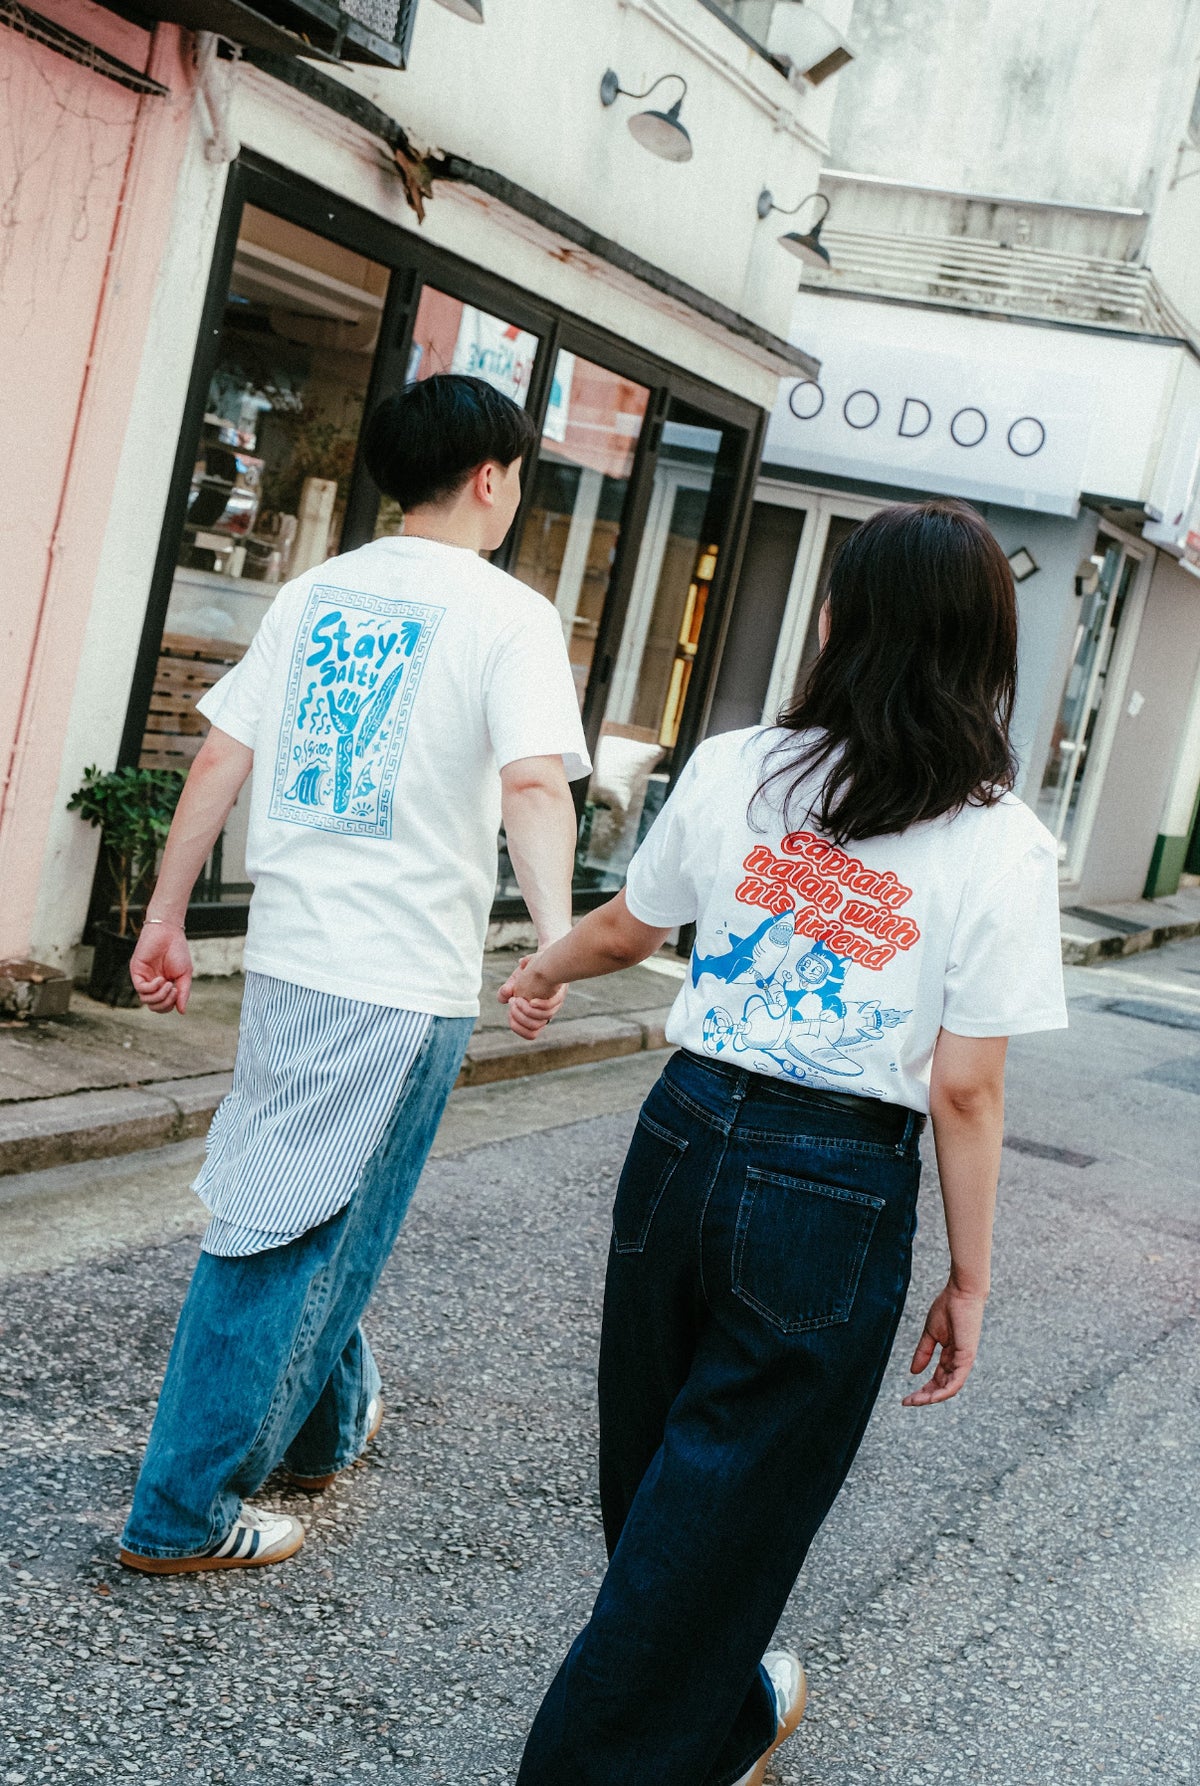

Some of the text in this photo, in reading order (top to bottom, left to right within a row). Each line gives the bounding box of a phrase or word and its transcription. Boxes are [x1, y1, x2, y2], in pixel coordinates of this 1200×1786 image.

[735, 876, 897, 972] his friend
[839, 900, 921, 951] with
